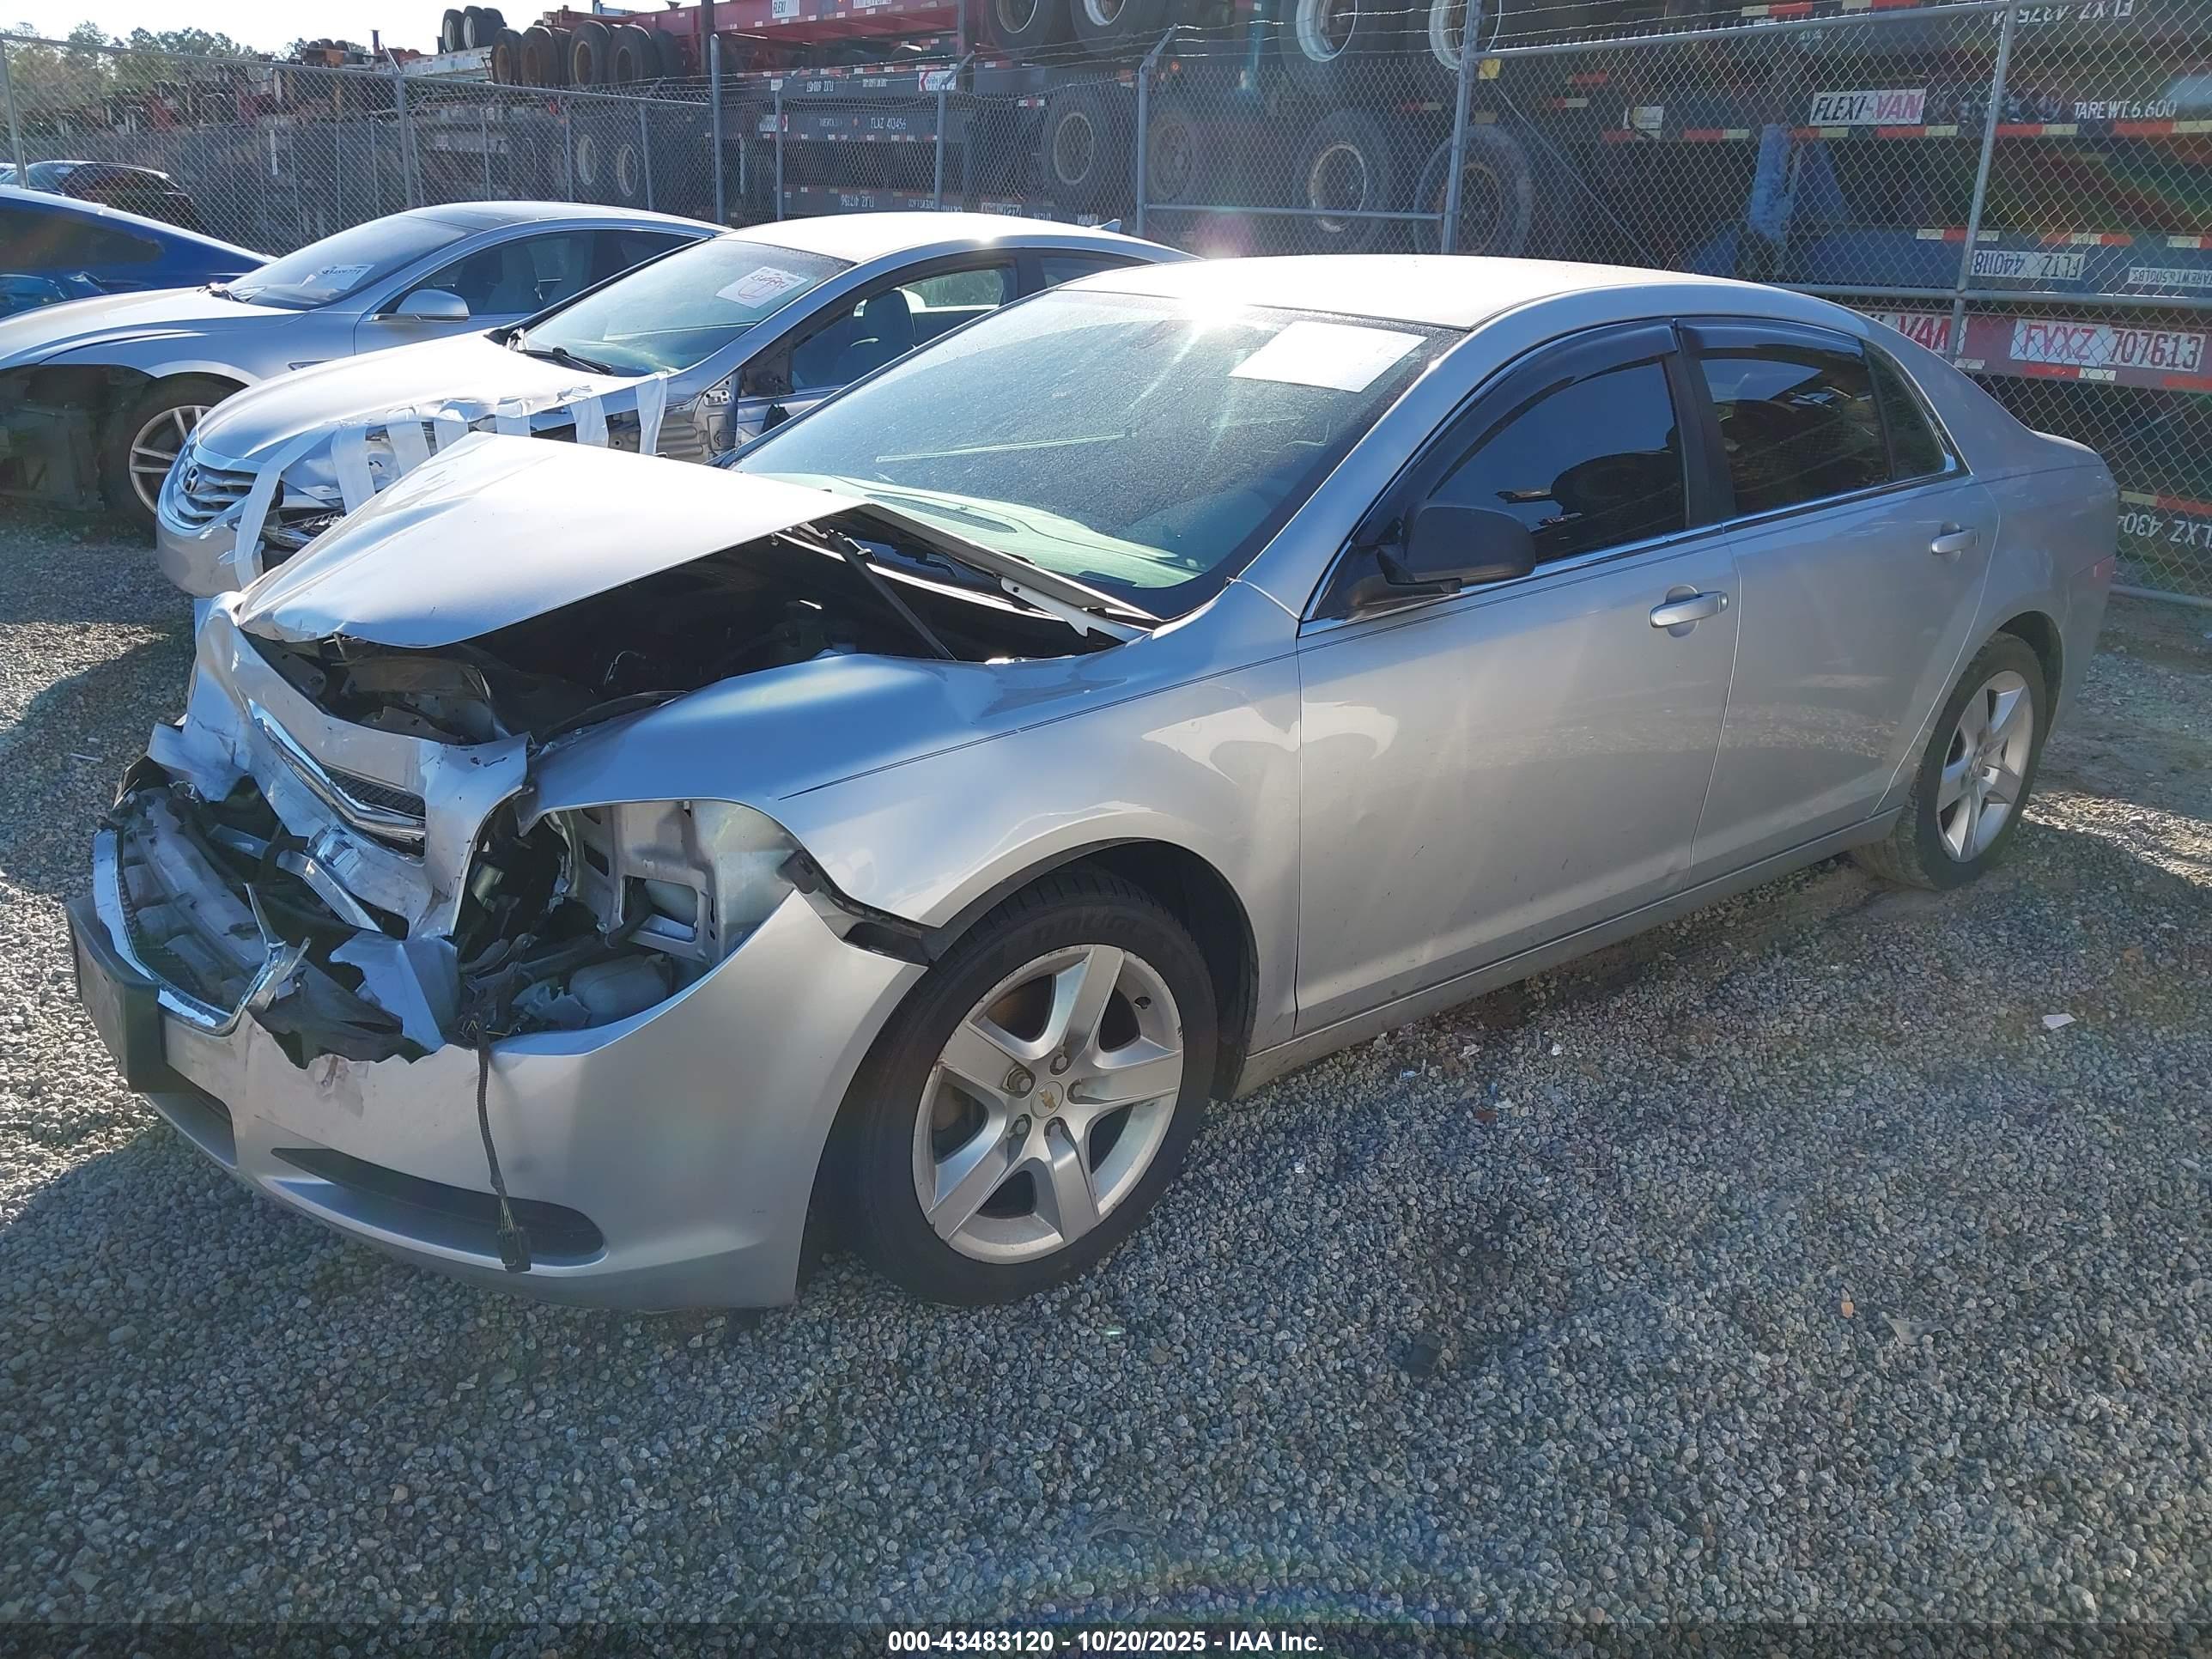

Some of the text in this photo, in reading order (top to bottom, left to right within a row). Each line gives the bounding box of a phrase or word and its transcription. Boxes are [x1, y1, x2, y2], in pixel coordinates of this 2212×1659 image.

[2074, 102, 2106, 119] TARE
[2024, 324, 2202, 369] FVXZ 707613
[2170, 520, 2212, 548] LXZ
